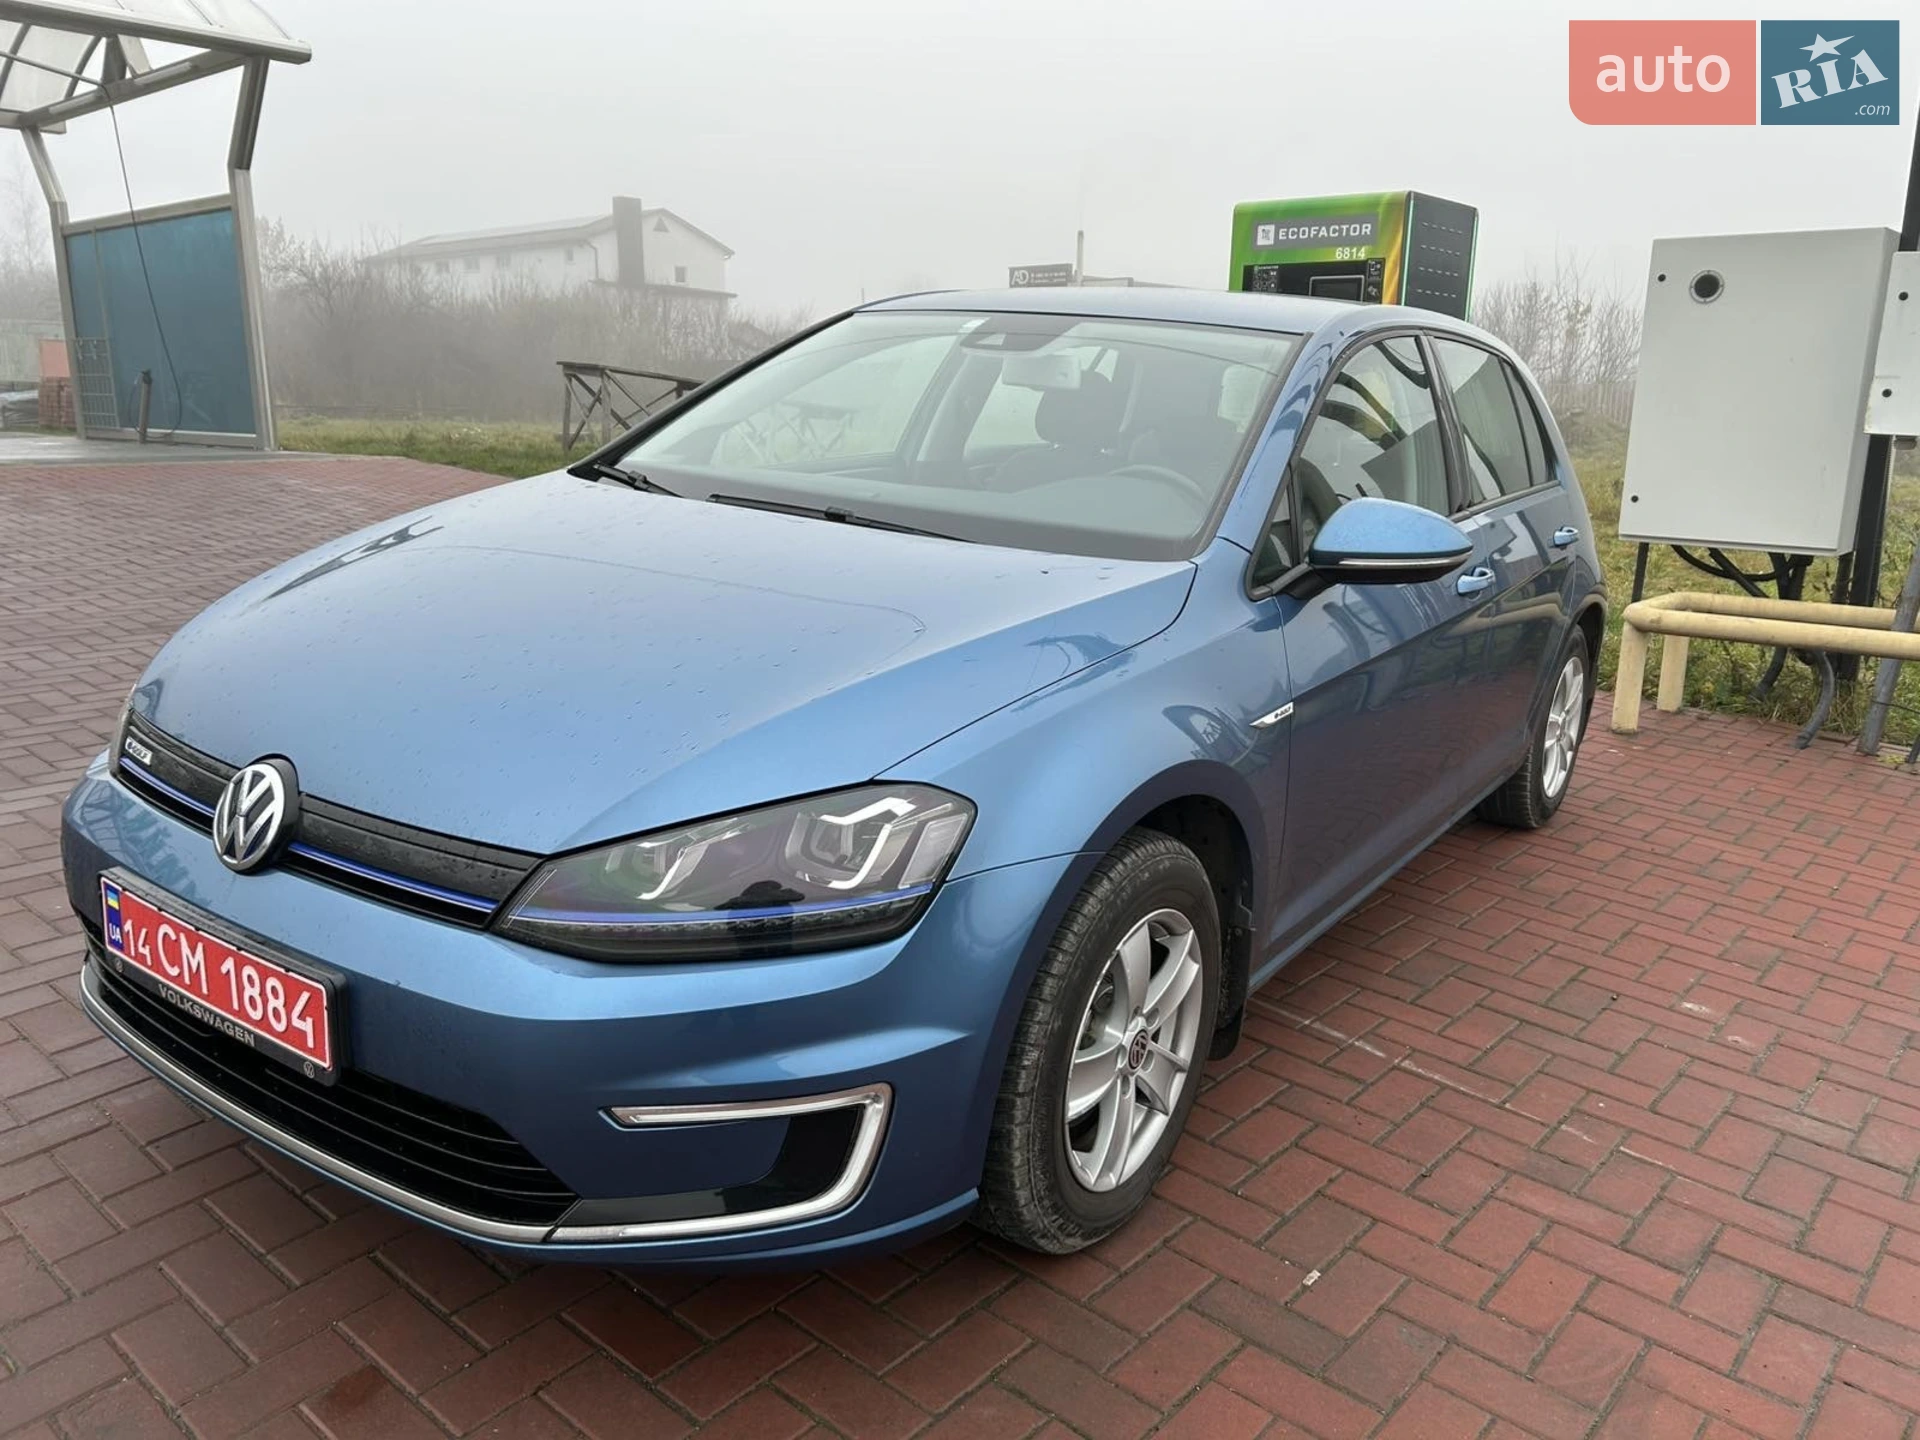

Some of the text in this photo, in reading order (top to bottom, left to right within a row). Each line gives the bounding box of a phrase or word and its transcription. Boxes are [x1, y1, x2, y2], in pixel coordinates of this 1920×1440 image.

[1278, 223, 1372, 240] ECOFACTOR
[1335, 246, 1366, 260] 6814
[108, 922, 123, 944] UA
[220, 956, 315, 1049] 1884
[158, 983, 256, 1047] VOLKSWAGEN
